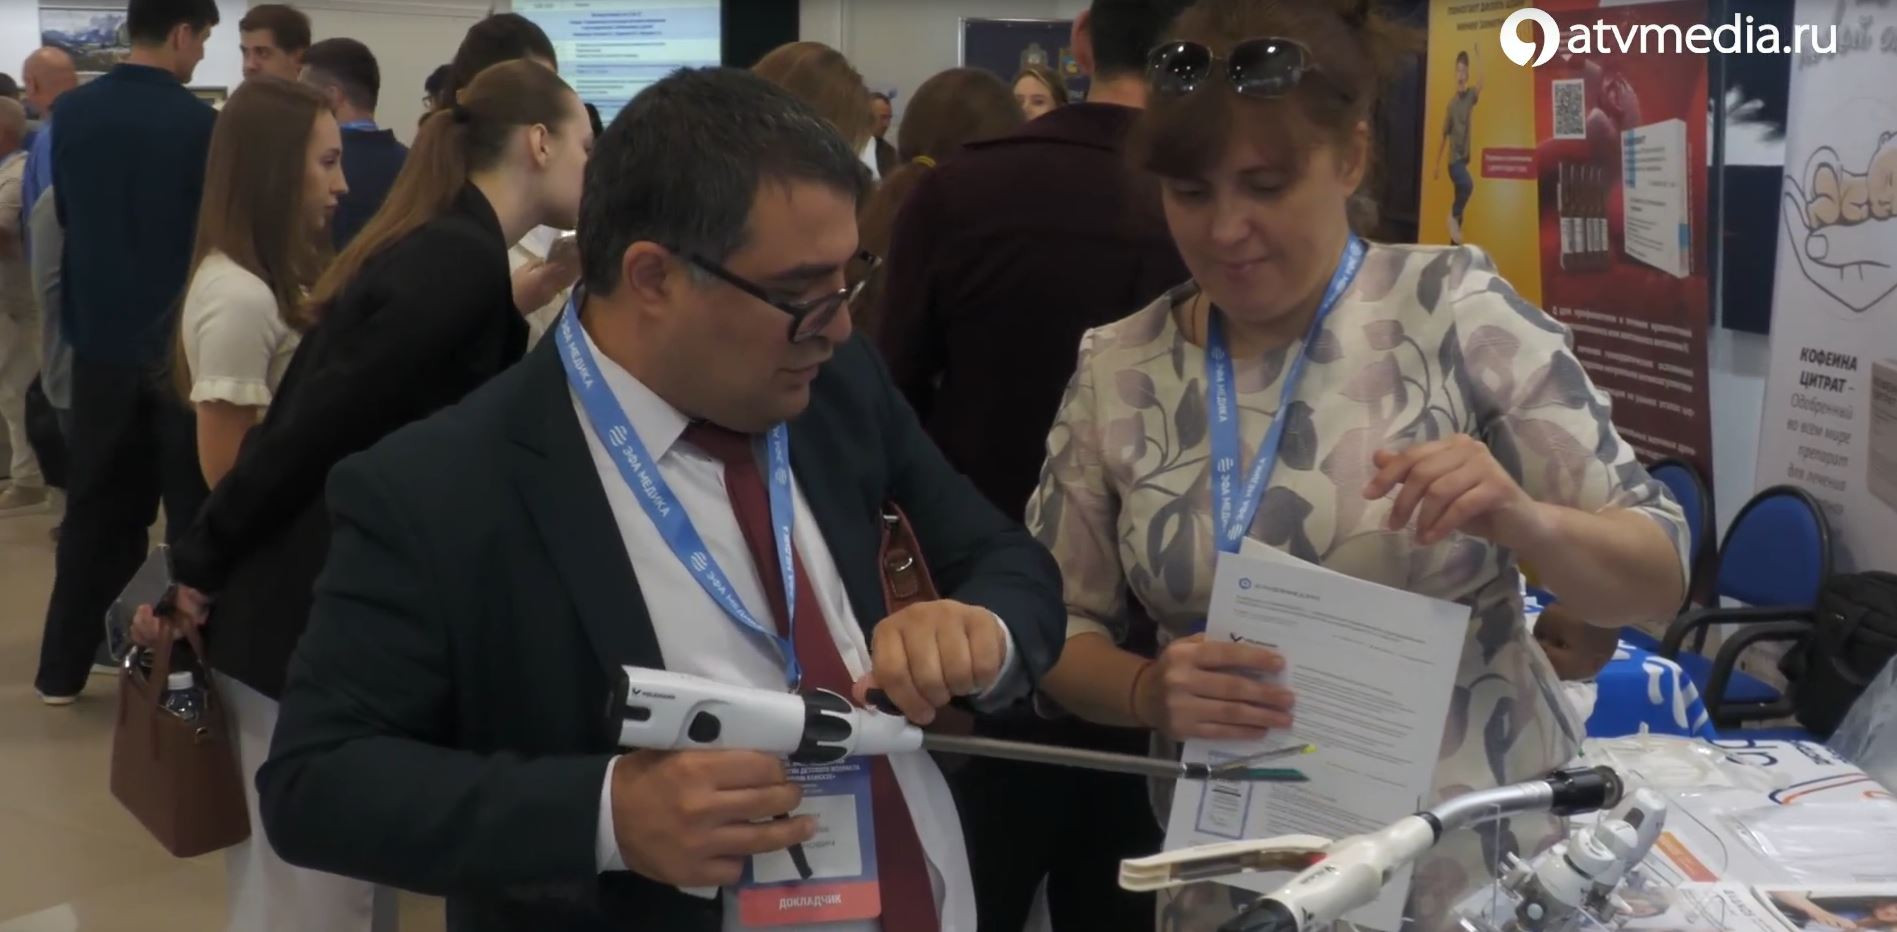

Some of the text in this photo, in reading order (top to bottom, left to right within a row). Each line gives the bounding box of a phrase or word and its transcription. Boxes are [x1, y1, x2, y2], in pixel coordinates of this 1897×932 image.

[569, 341, 594, 389] МЕДИКА
[1799, 347, 1858, 371] КОФЕИНА
[1799, 370, 1848, 393] ЦИТРАТ
[621, 445, 670, 517] ЭФА МЕДИКА
[780, 894, 841, 909] ДОКЛАДЧИК
